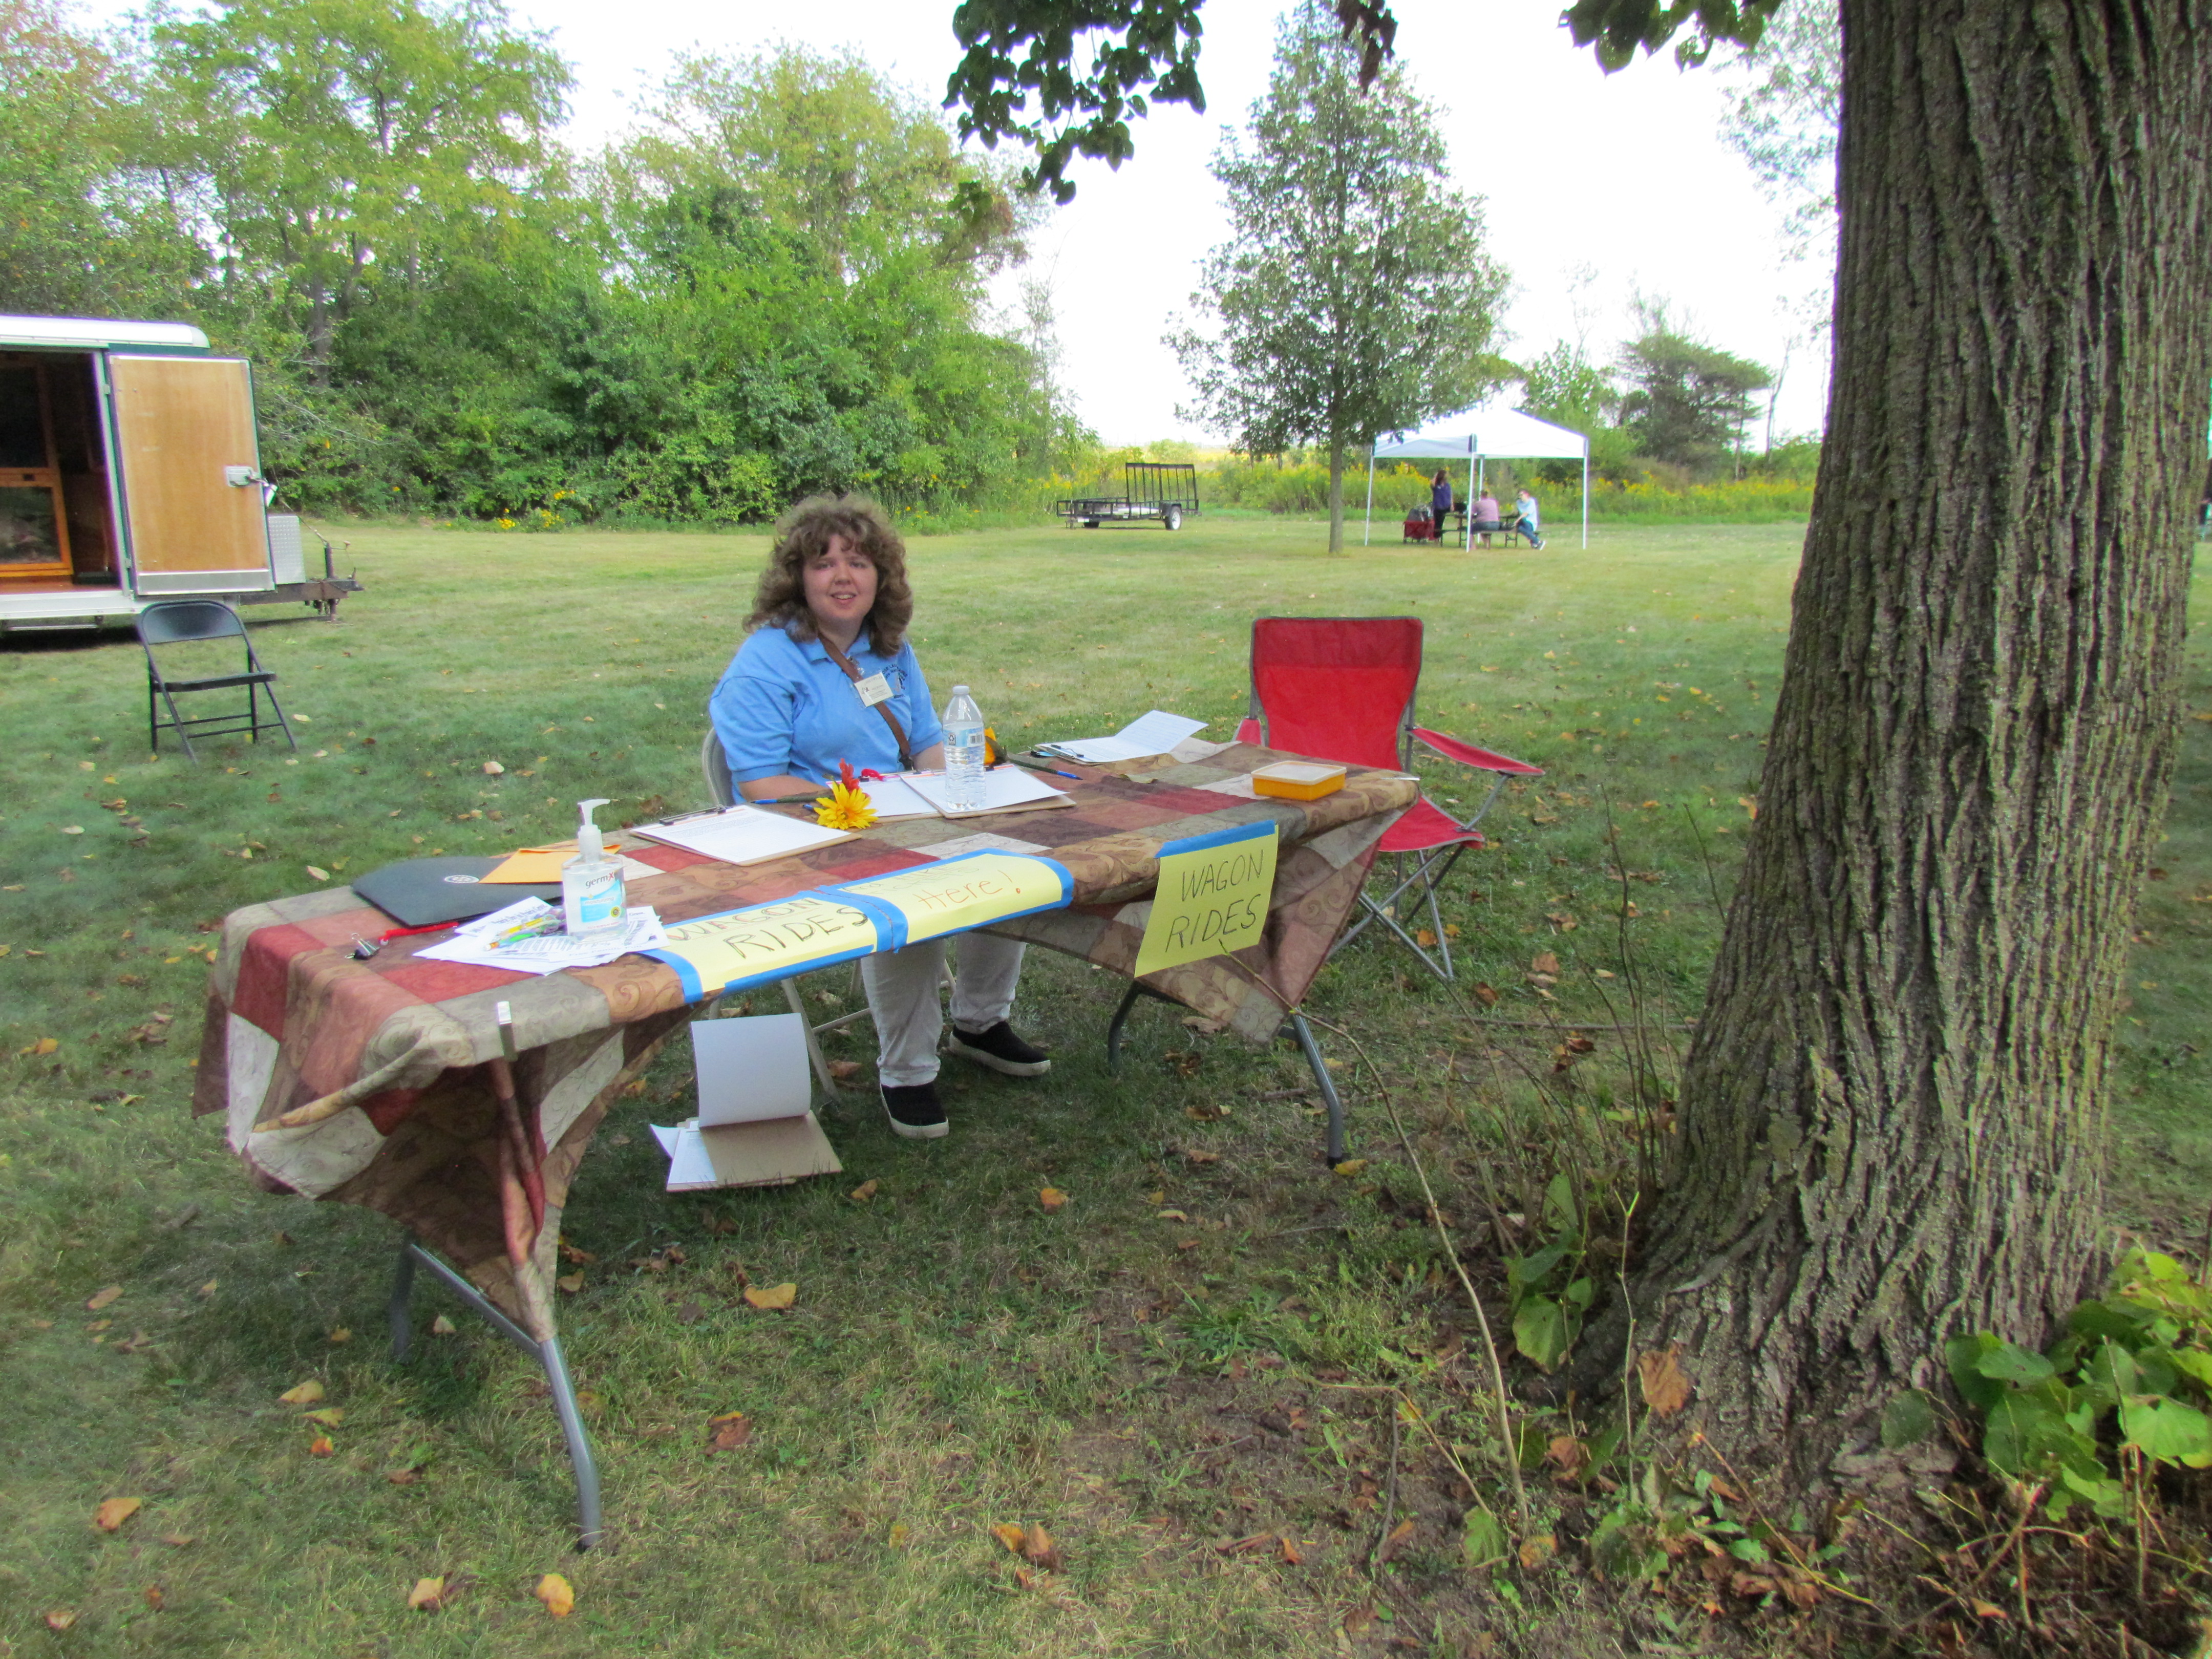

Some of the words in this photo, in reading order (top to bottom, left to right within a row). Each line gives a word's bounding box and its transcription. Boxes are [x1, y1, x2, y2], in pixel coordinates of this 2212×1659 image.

[912, 869, 1022, 909] Here!
[1182, 849, 1264, 902] WAGON
[666, 897, 823, 941] WAGON
[722, 906, 869, 959] RIDES
[1165, 894, 1262, 953] RIDES
